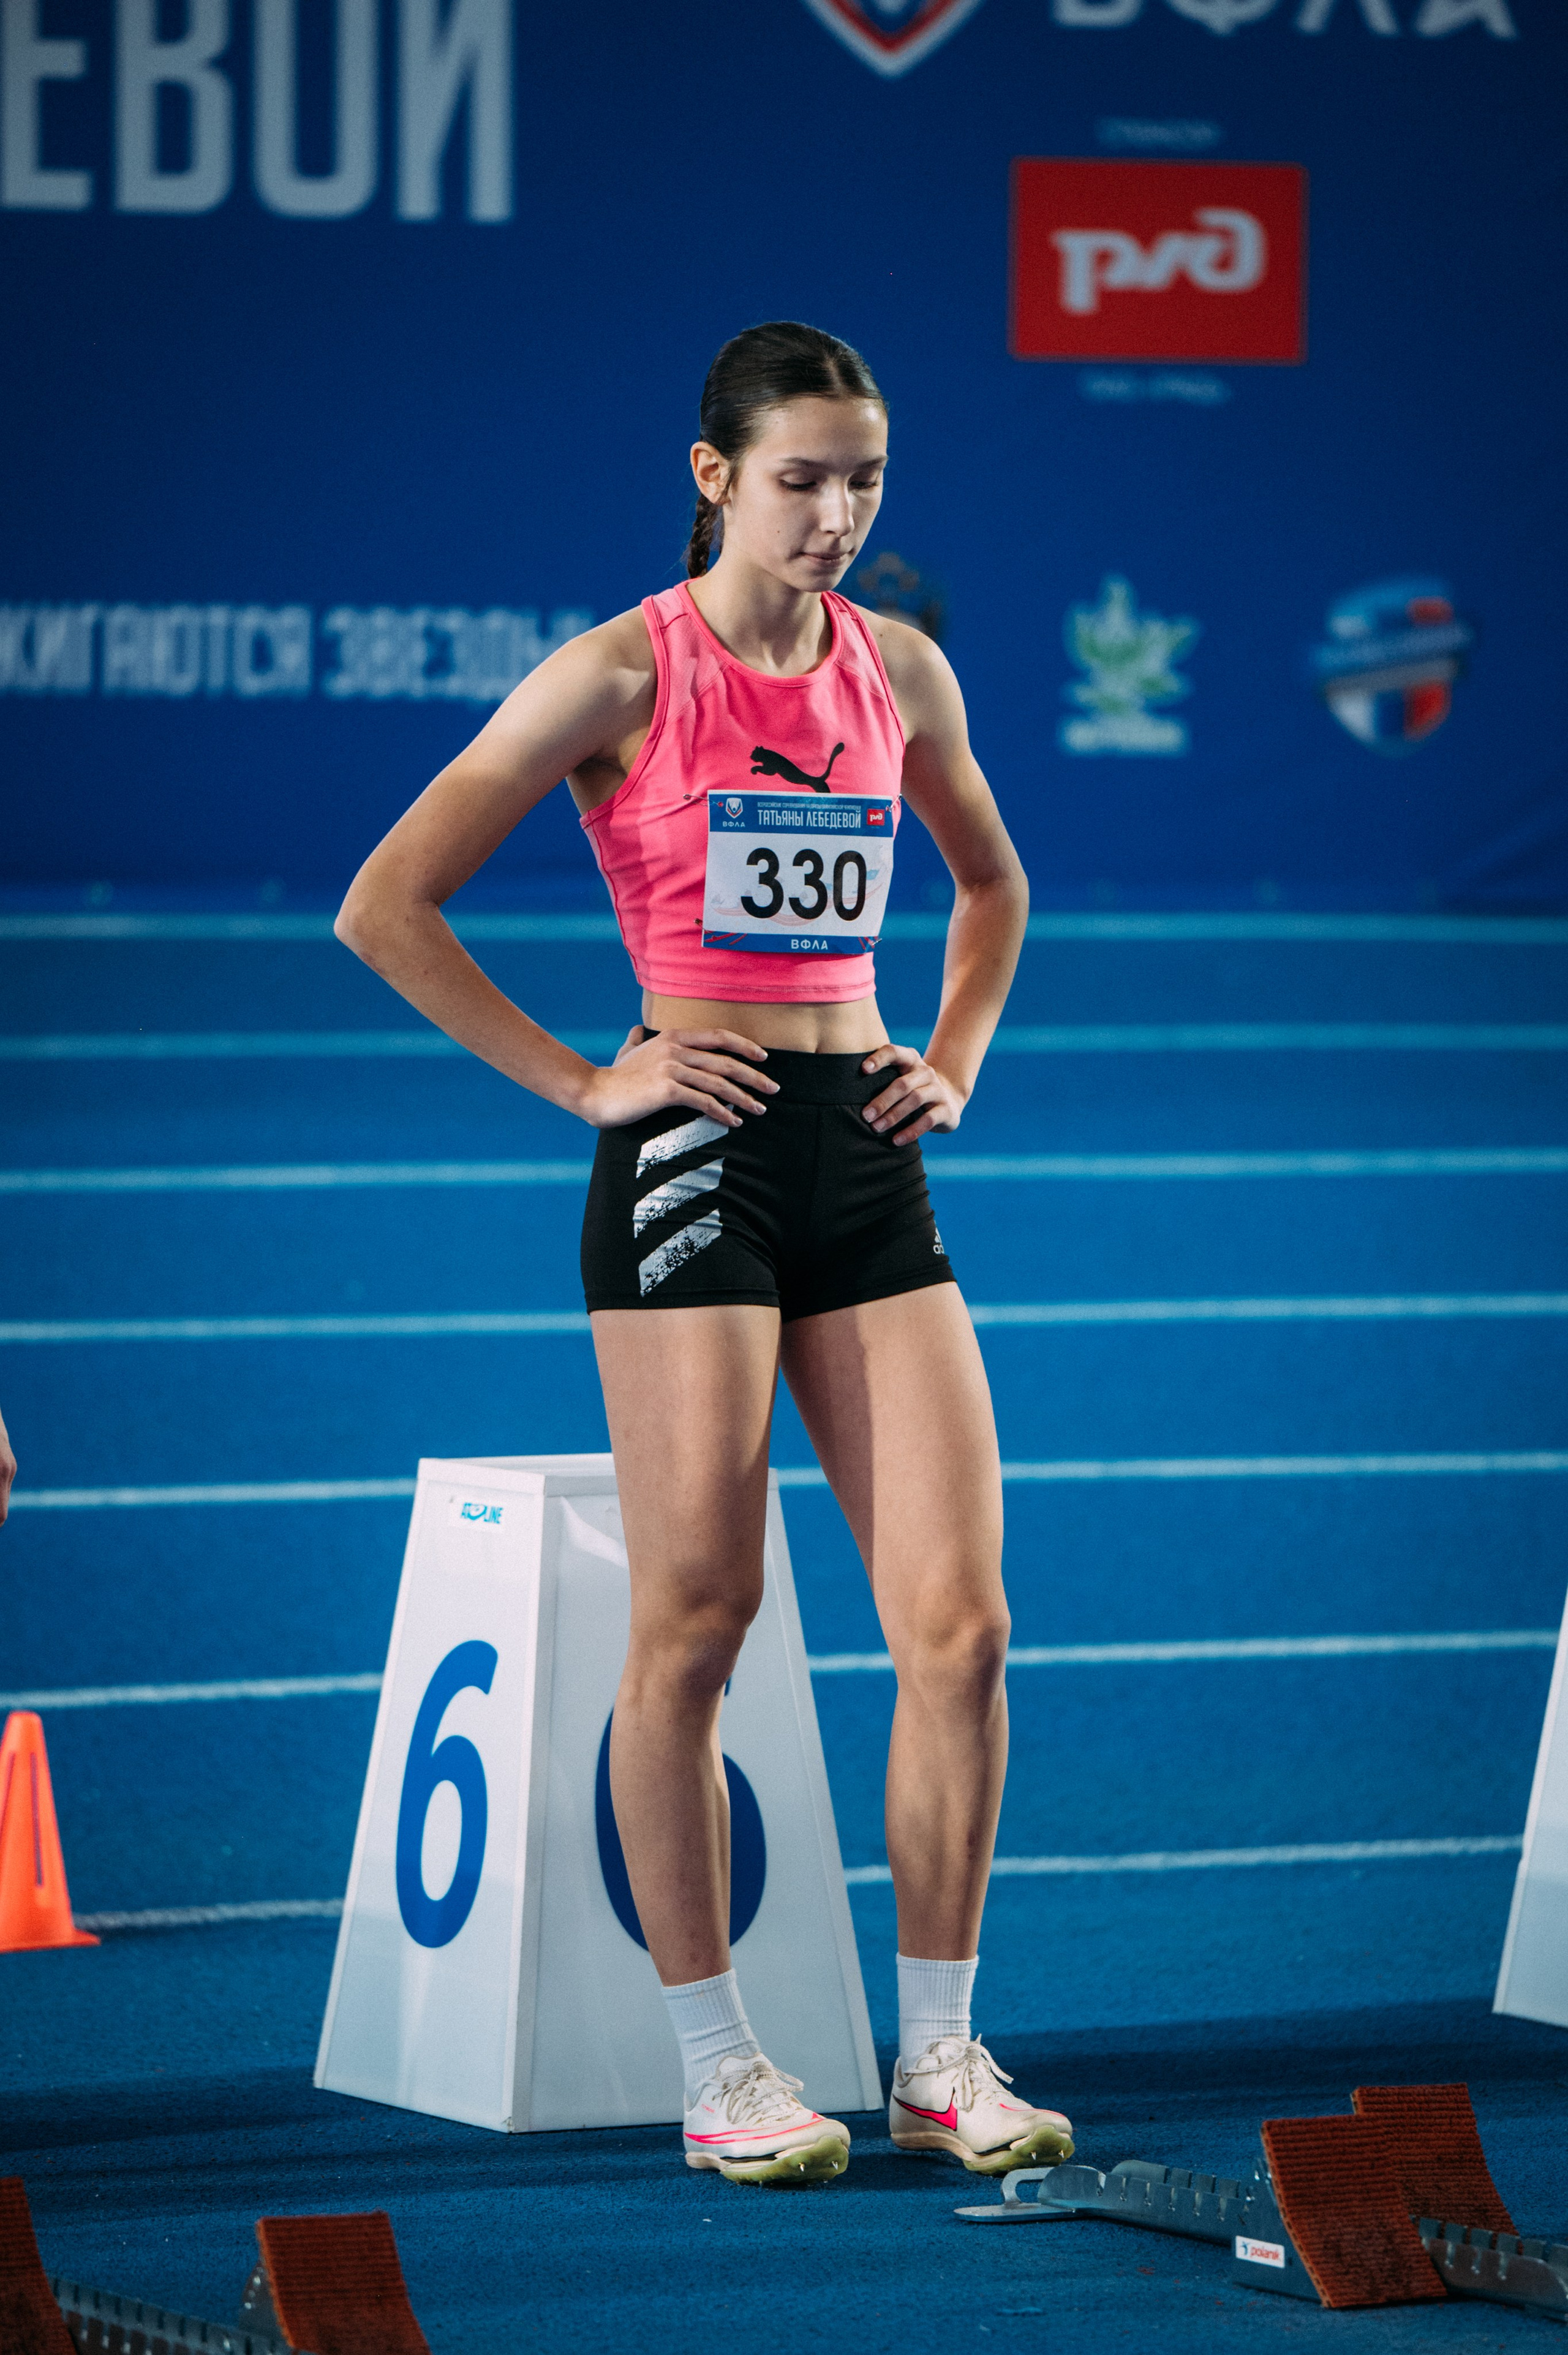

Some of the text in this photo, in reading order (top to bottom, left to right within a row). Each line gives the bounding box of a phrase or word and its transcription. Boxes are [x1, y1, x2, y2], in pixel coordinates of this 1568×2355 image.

[757, 809, 861, 830] ТАТЬЯНЫ ЛЕБЕДЕВОЙ
[741, 847, 867, 921] 330
[791, 939, 828, 950] ВФЛА
[396, 1639, 498, 1948] 6
